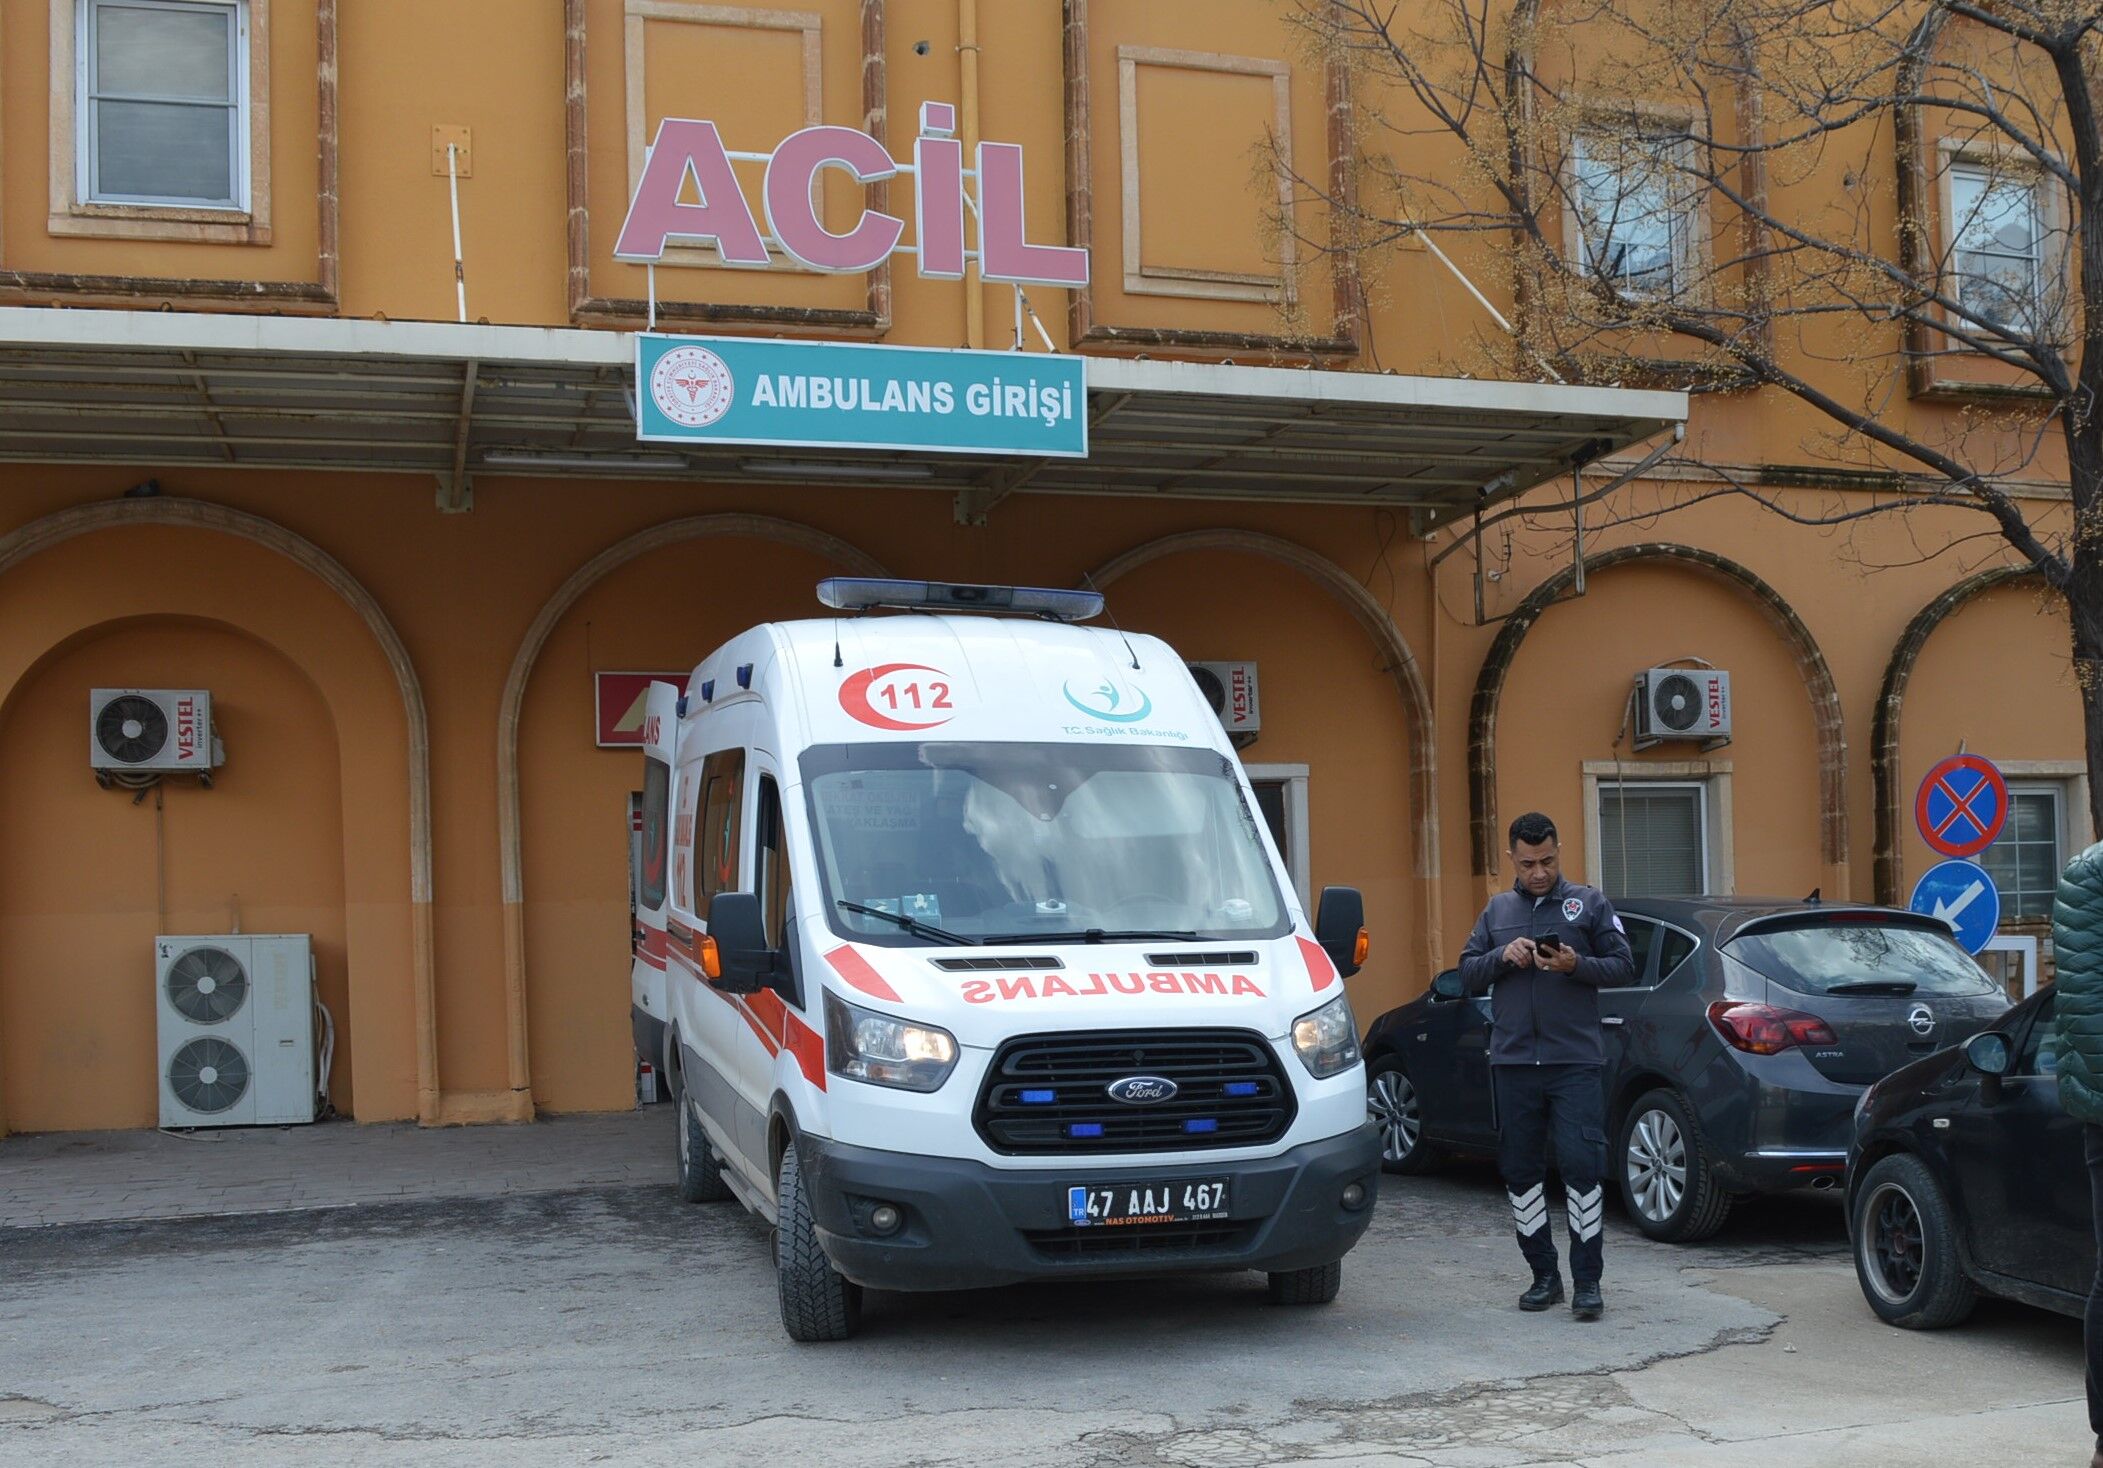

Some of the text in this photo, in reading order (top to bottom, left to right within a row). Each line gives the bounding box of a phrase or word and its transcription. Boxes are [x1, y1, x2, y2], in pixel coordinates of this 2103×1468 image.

[613, 101, 1090, 287] ACİL
[751, 374, 1072, 427] AMBULANS GİRİŞİ
[880, 682, 953, 709] 112
[1232, 666, 1246, 724] VESTEL
[1708, 676, 1721, 728] VESTEL
[178, 696, 193, 760] VESTEL
[1126, 1081, 1163, 1098] Ford
[1074, 1183, 1223, 1217] TR 47 AAJ 467
[1105, 1217, 1124, 1225] NAS
